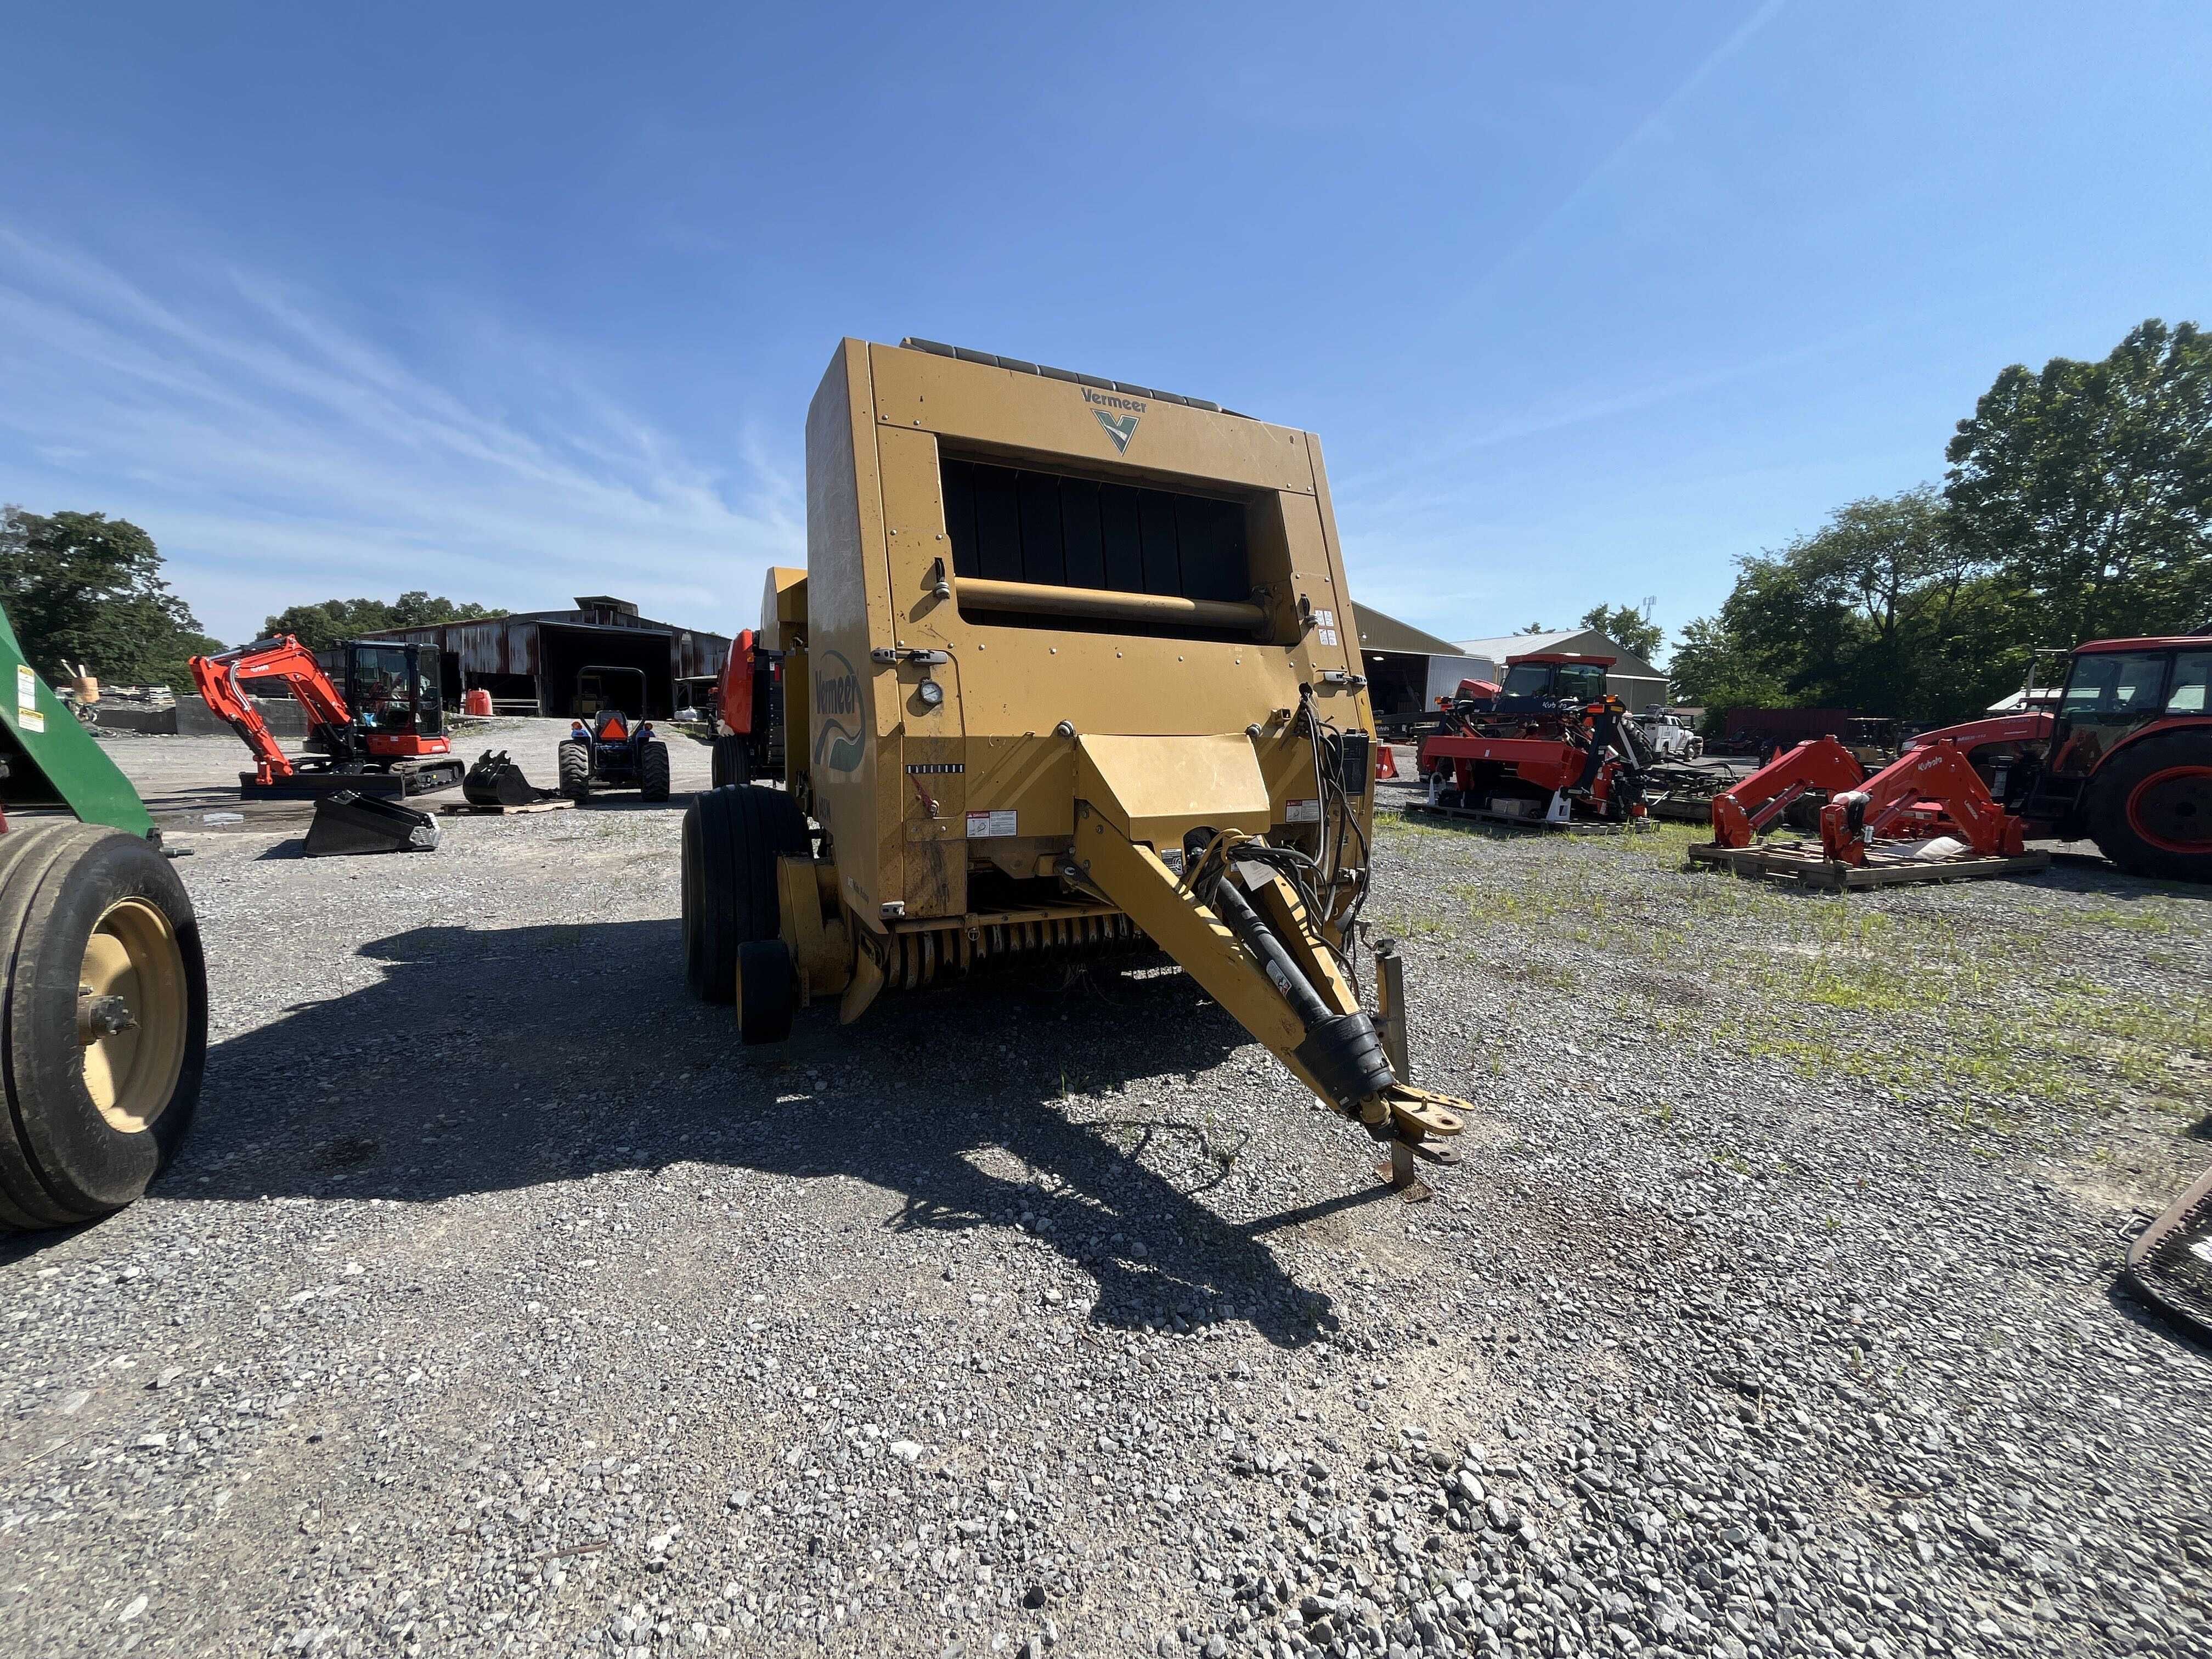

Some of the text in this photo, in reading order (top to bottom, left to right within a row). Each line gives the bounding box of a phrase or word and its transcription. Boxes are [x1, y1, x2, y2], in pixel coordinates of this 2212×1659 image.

[1081, 387, 1147, 413] Vermeer
[815, 670, 857, 714] Vermeer
[1917, 756, 1942, 771] Kubota
